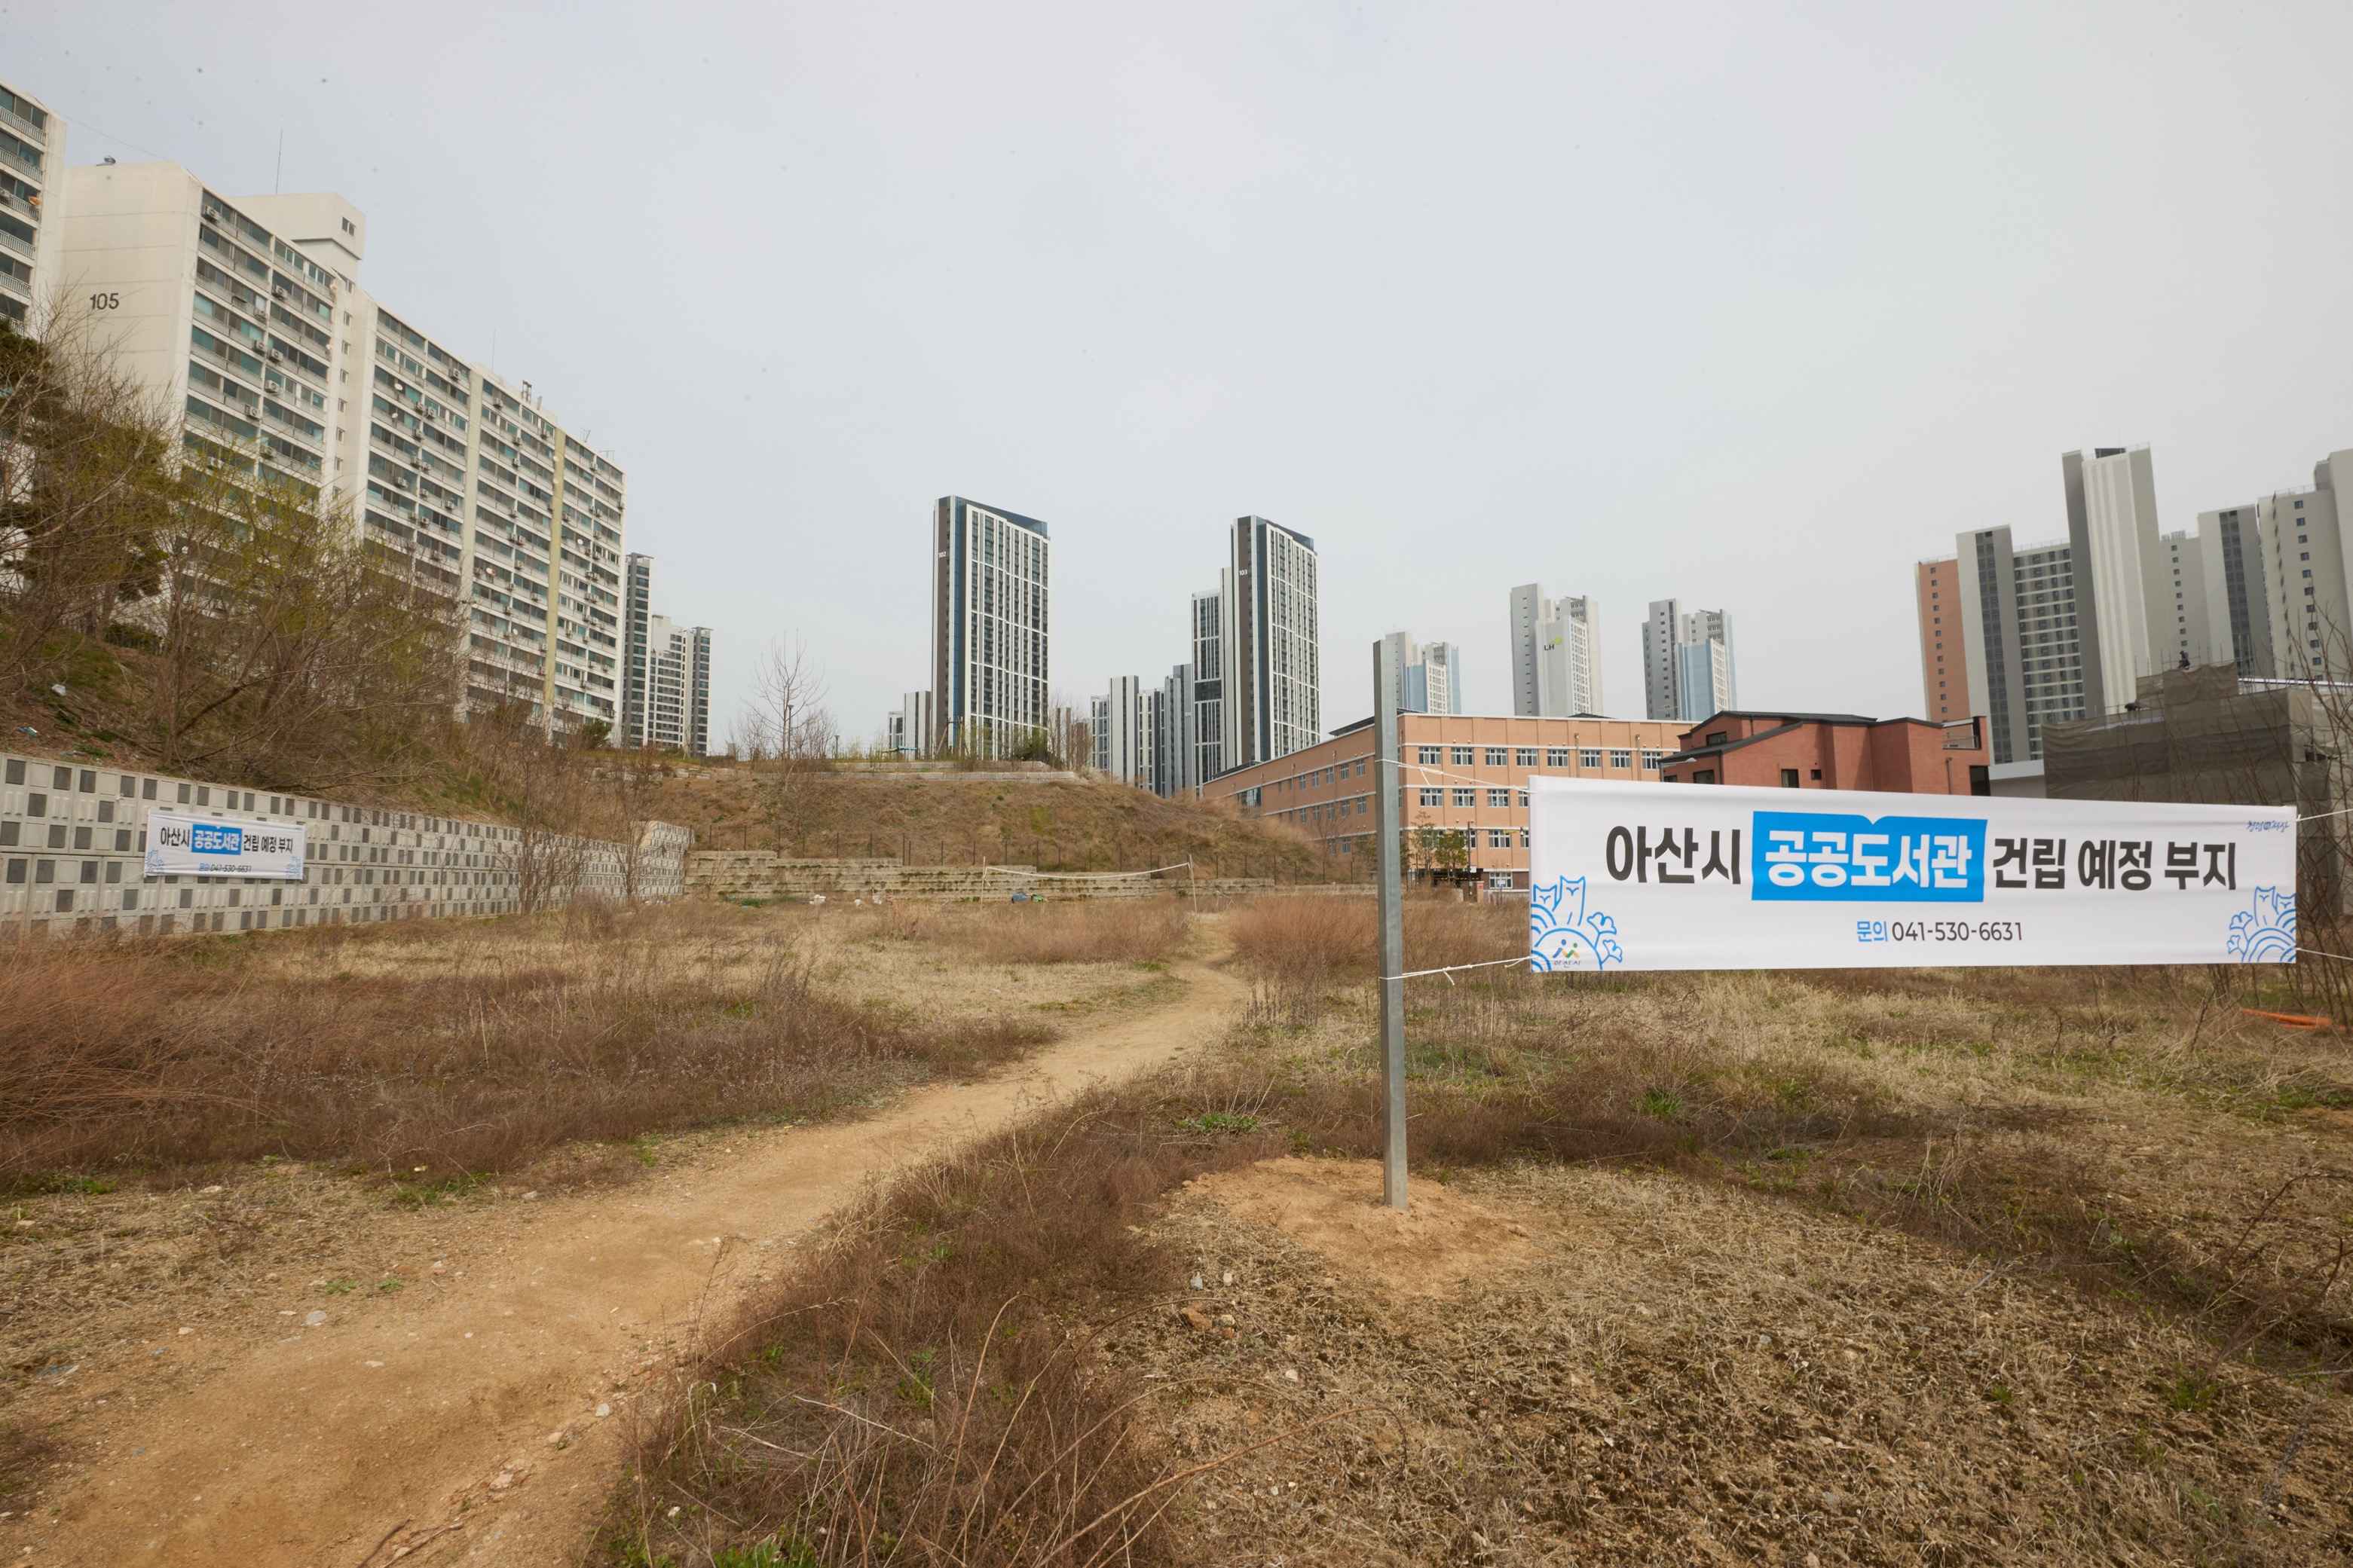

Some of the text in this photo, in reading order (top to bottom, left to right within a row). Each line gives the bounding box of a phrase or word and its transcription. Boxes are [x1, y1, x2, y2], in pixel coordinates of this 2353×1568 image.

[90, 293, 119, 310] 105
[161, 827, 293, 853] 아산시 공공도서관 건립 예정 부지
[210, 863, 252, 873] 041-530-6631
[1605, 825, 2236, 891] 아산시 공공도서관 건립 예정 부지
[1856, 921, 2022, 942] 문의 041-530-6631
